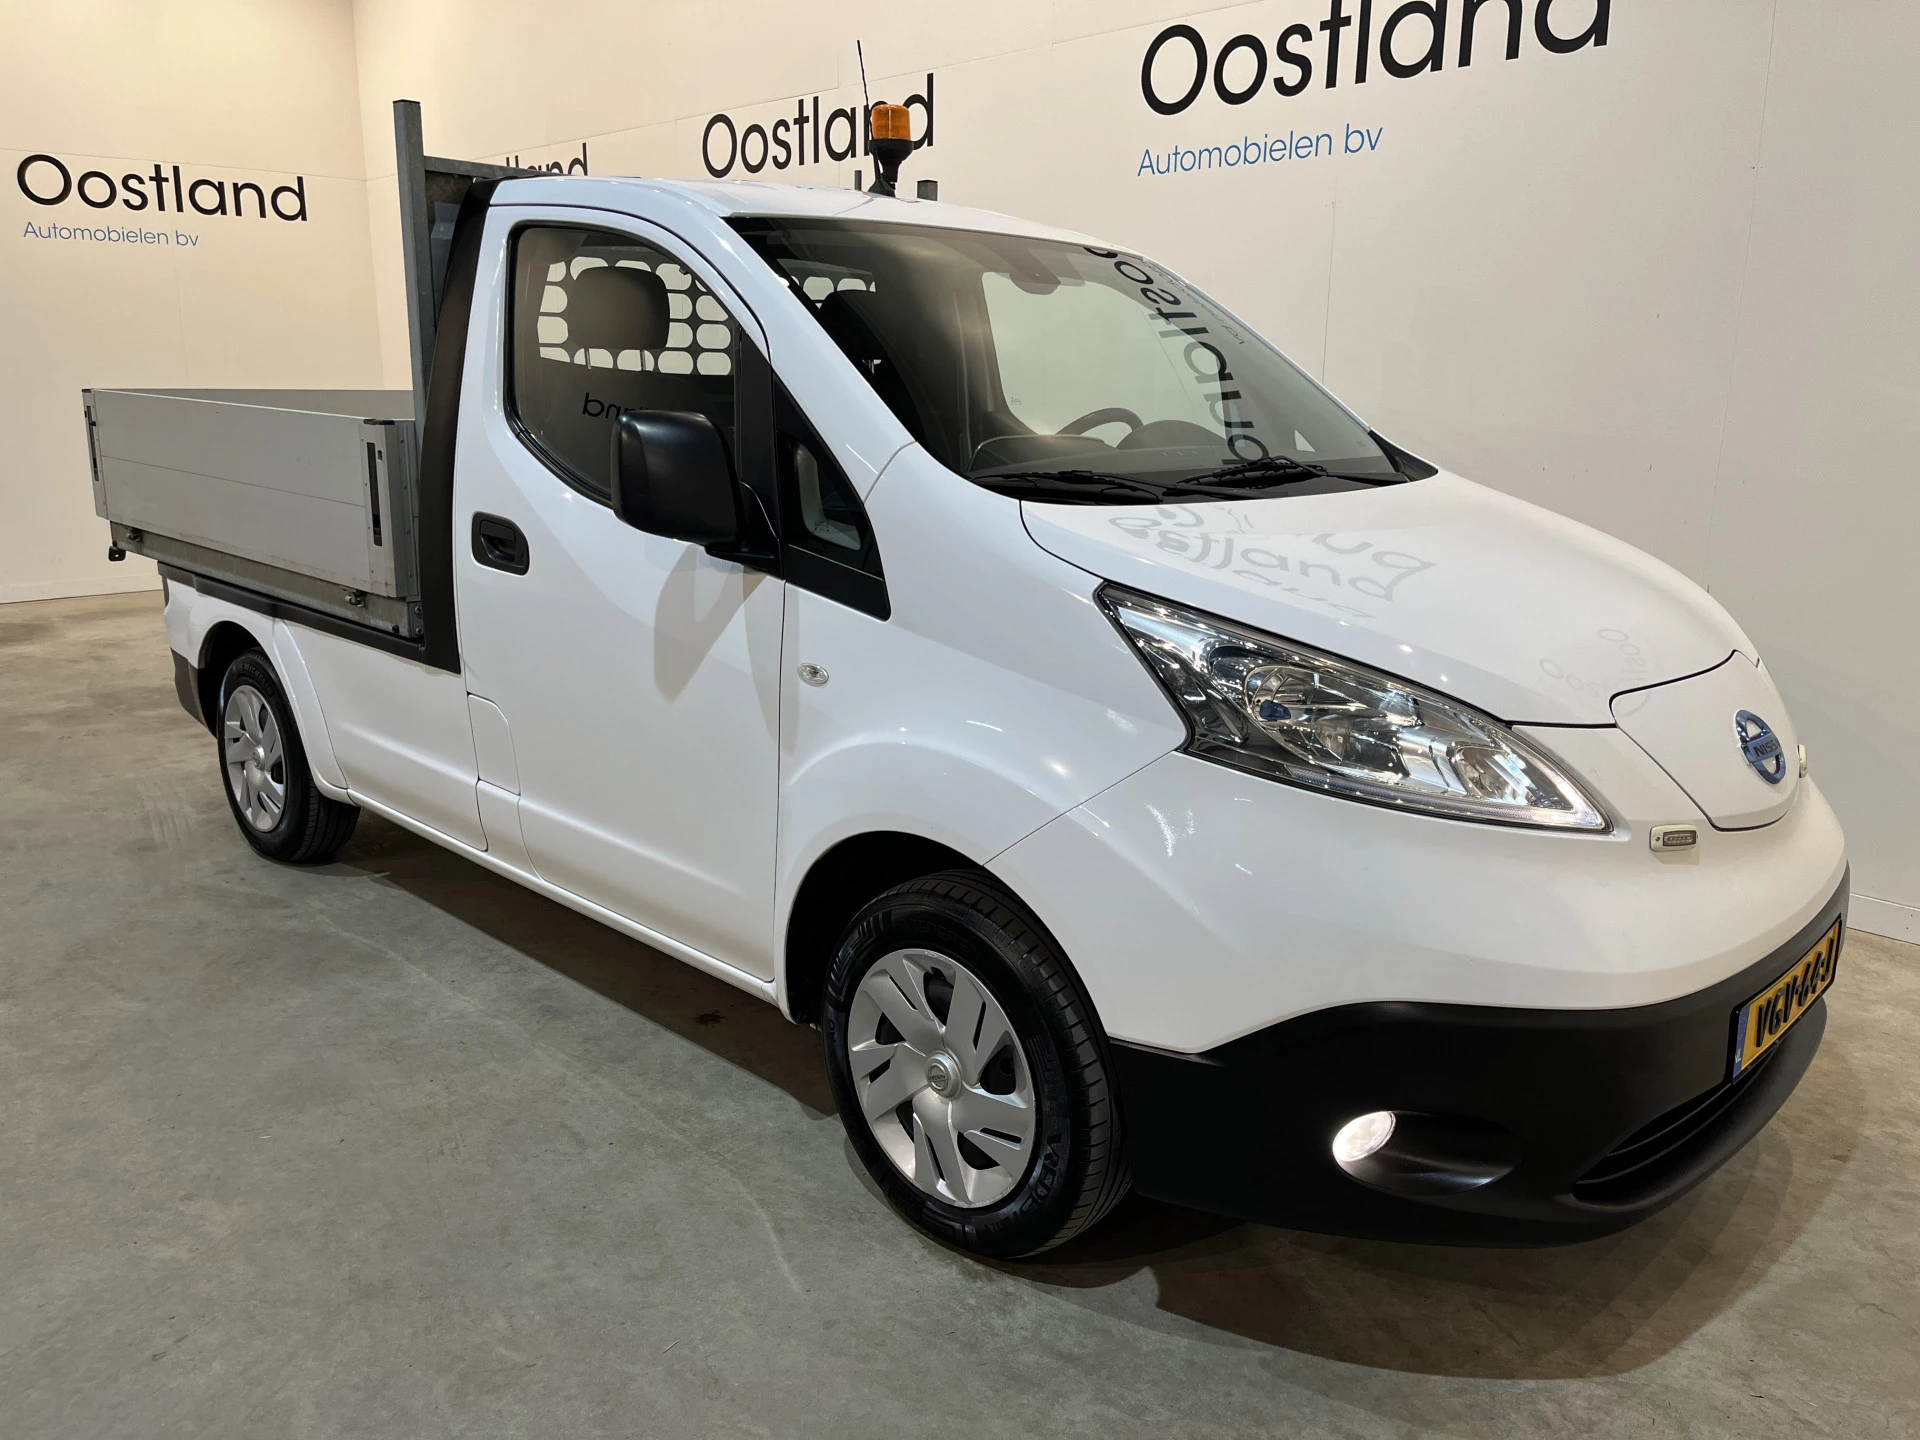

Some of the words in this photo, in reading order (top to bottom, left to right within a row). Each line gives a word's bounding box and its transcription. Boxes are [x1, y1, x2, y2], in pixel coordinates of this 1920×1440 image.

[1137, 129, 1333, 177] Automobielen
[1344, 123, 1384, 154] bv
[16, 154, 308, 222] Oostland
[23, 221, 169, 245] Automobielen
[175, 230, 199, 247] bv
